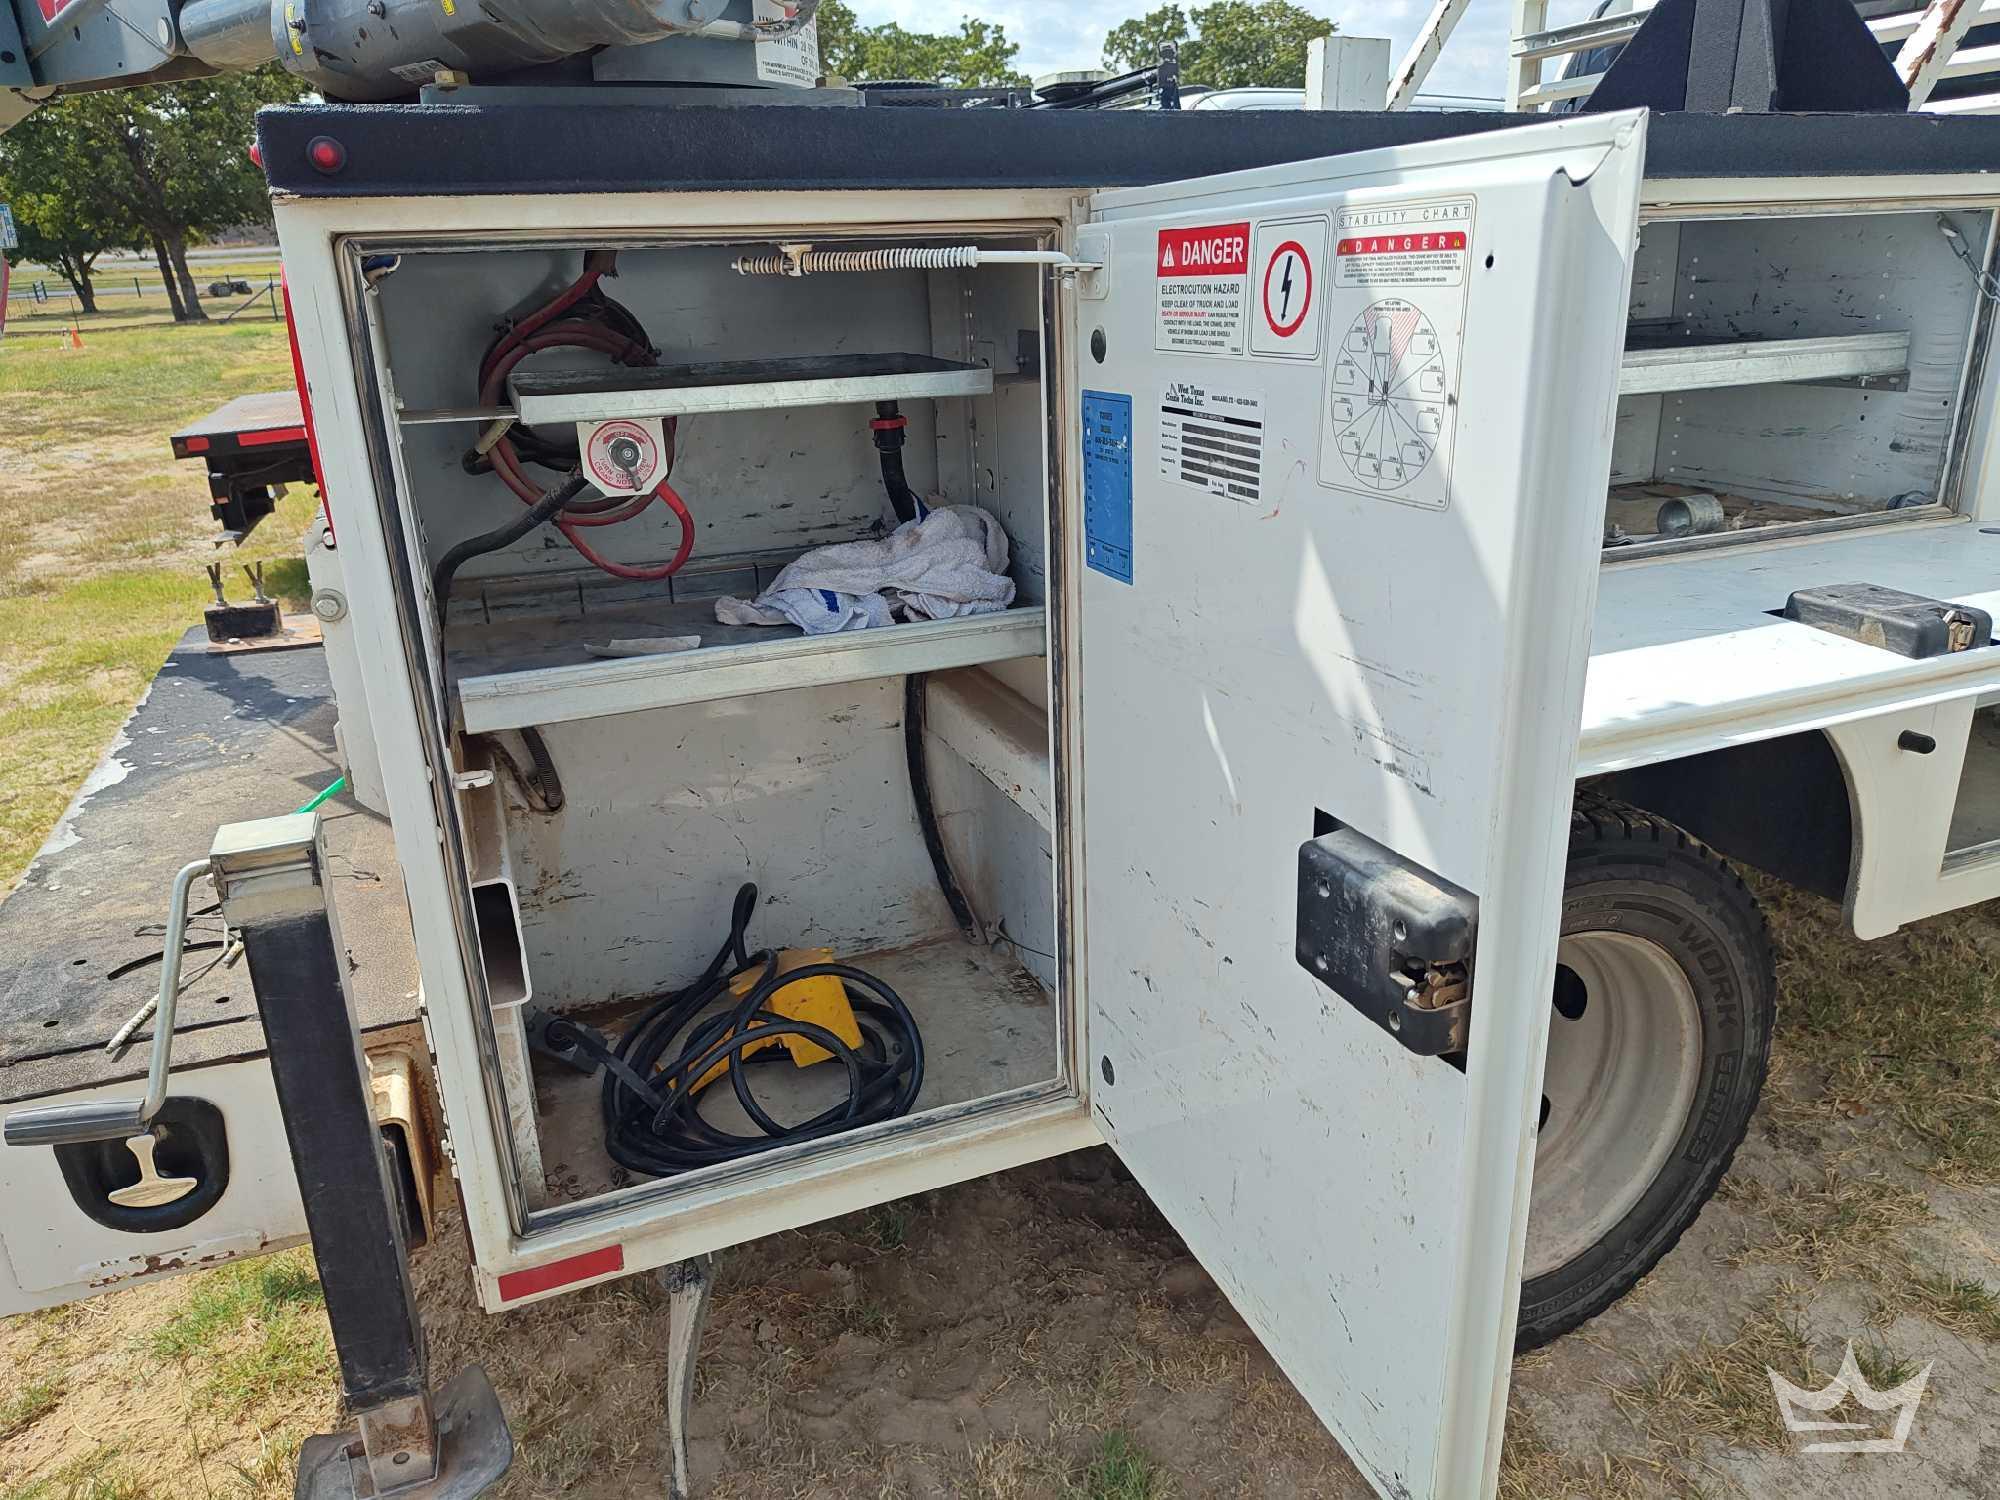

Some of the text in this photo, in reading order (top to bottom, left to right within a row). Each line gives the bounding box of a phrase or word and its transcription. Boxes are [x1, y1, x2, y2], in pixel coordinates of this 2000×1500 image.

[1338, 206, 1469, 229] STABILITY CHART
[1182, 236, 1244, 266] DANGER
[1355, 236, 1446, 253] DANGER
[1161, 283, 1240, 295] ELECTROCUTION HAZARD
[1161, 300, 1173, 308] KEEP
[1174, 300, 1188, 308] CLEAR
[1196, 300, 1213, 308] TRUCK
[1213, 300, 1224, 308] AND
[1225, 300, 1239, 308] LOAD
[1178, 383, 1205, 397] West Texas
[1194, 396, 1205, 407] Inc.
[1678, 920, 1737, 1163] WORK SERIES
